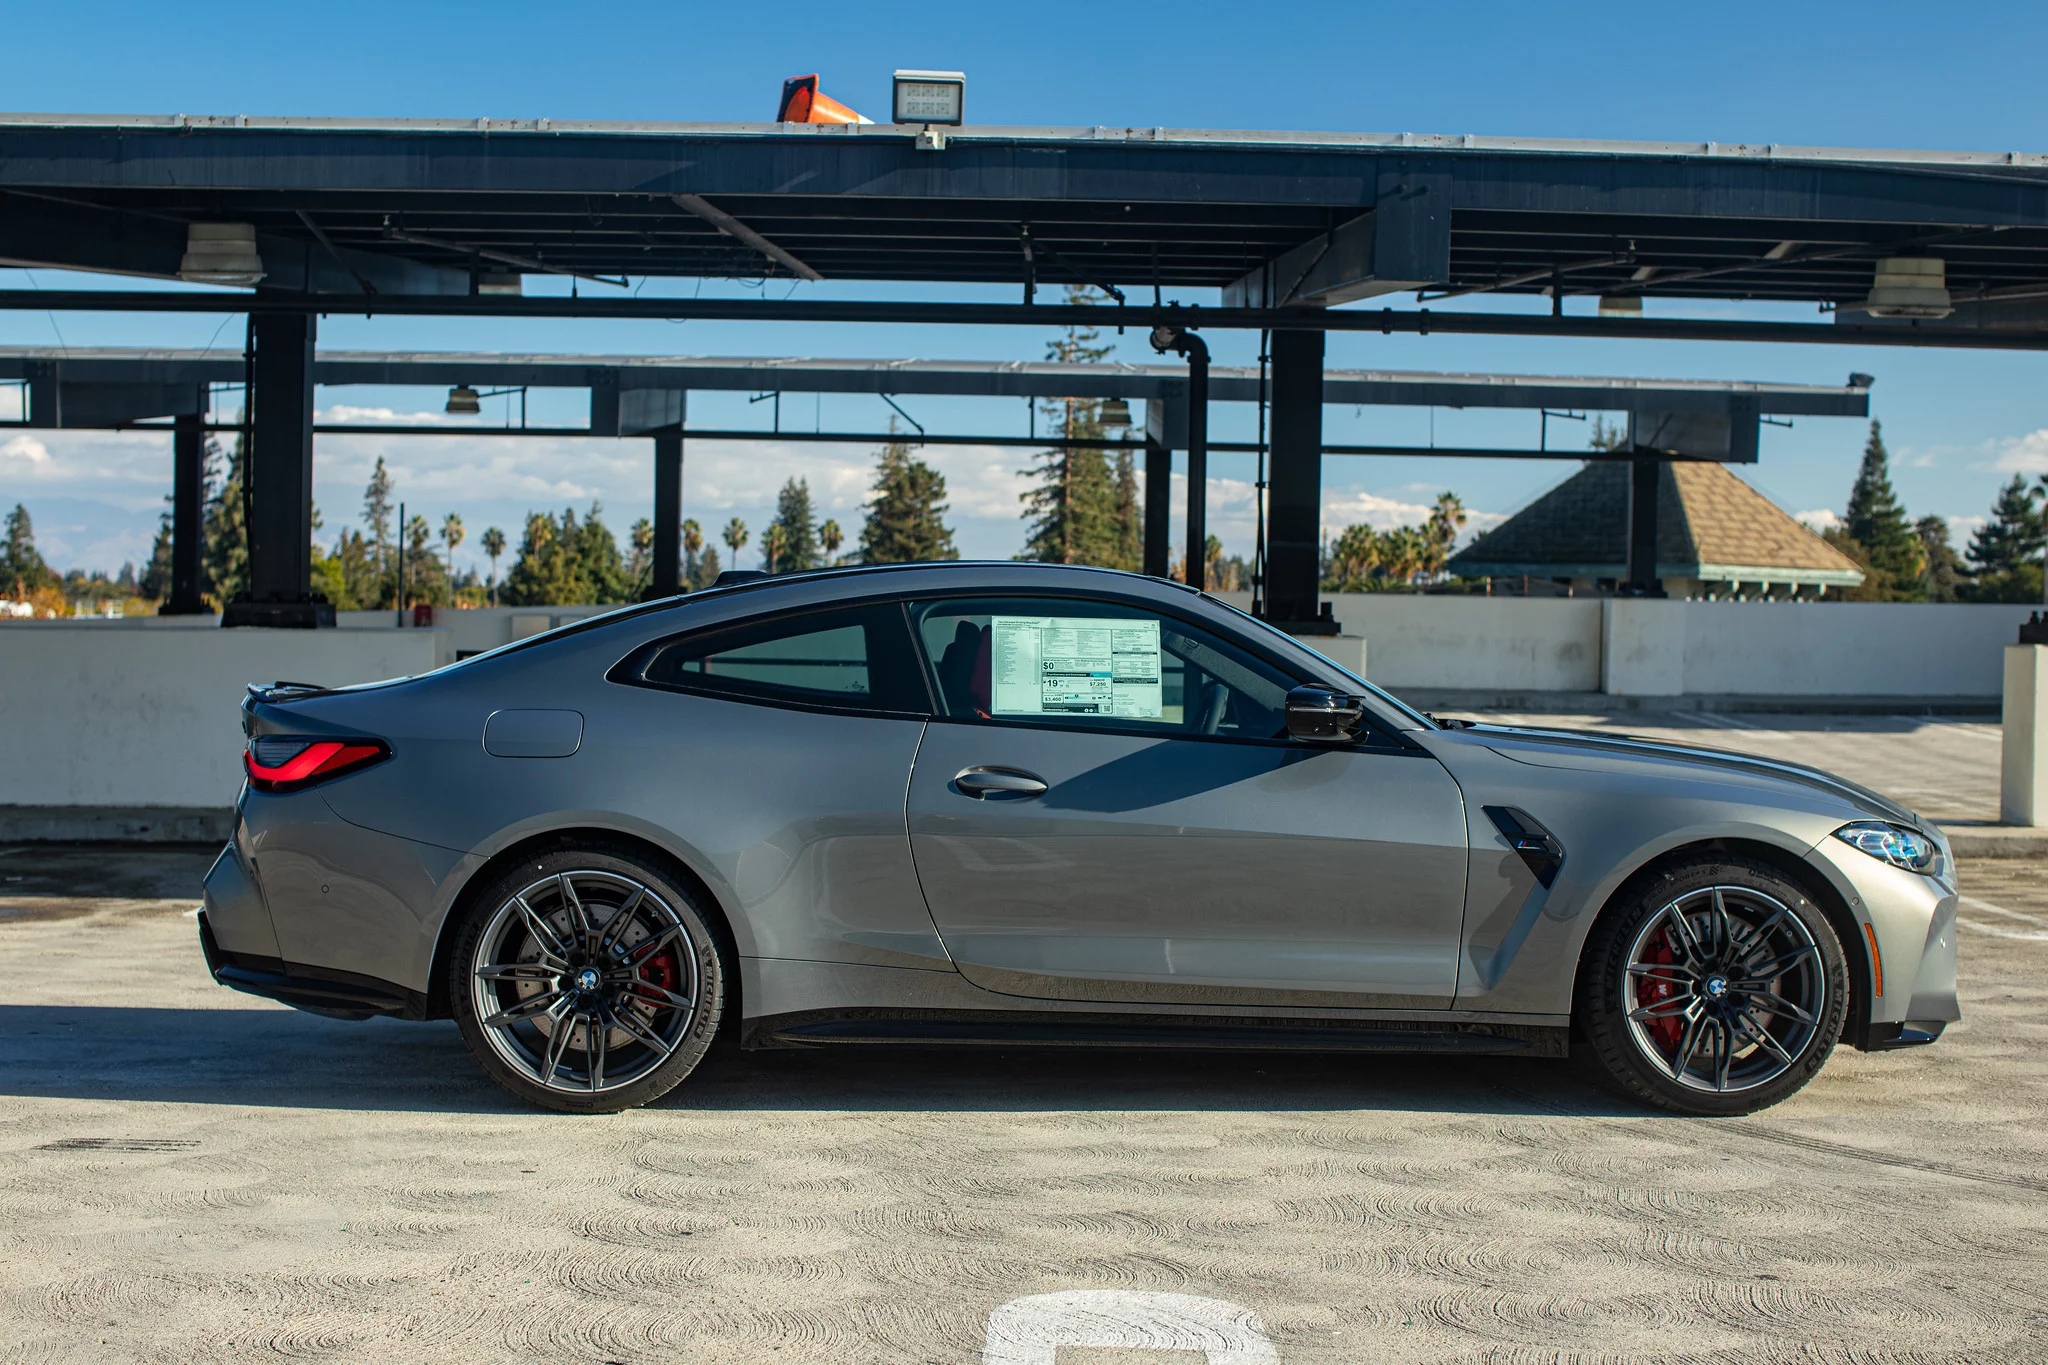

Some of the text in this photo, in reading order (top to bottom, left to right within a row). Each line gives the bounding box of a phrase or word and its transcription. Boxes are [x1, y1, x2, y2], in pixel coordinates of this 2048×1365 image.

[1043, 661, 1054, 670] $0
[1047, 679, 1058, 687] 19
[696, 966, 714, 1038] MICHELIN
[1808, 989, 1843, 1070] MICHELIN
